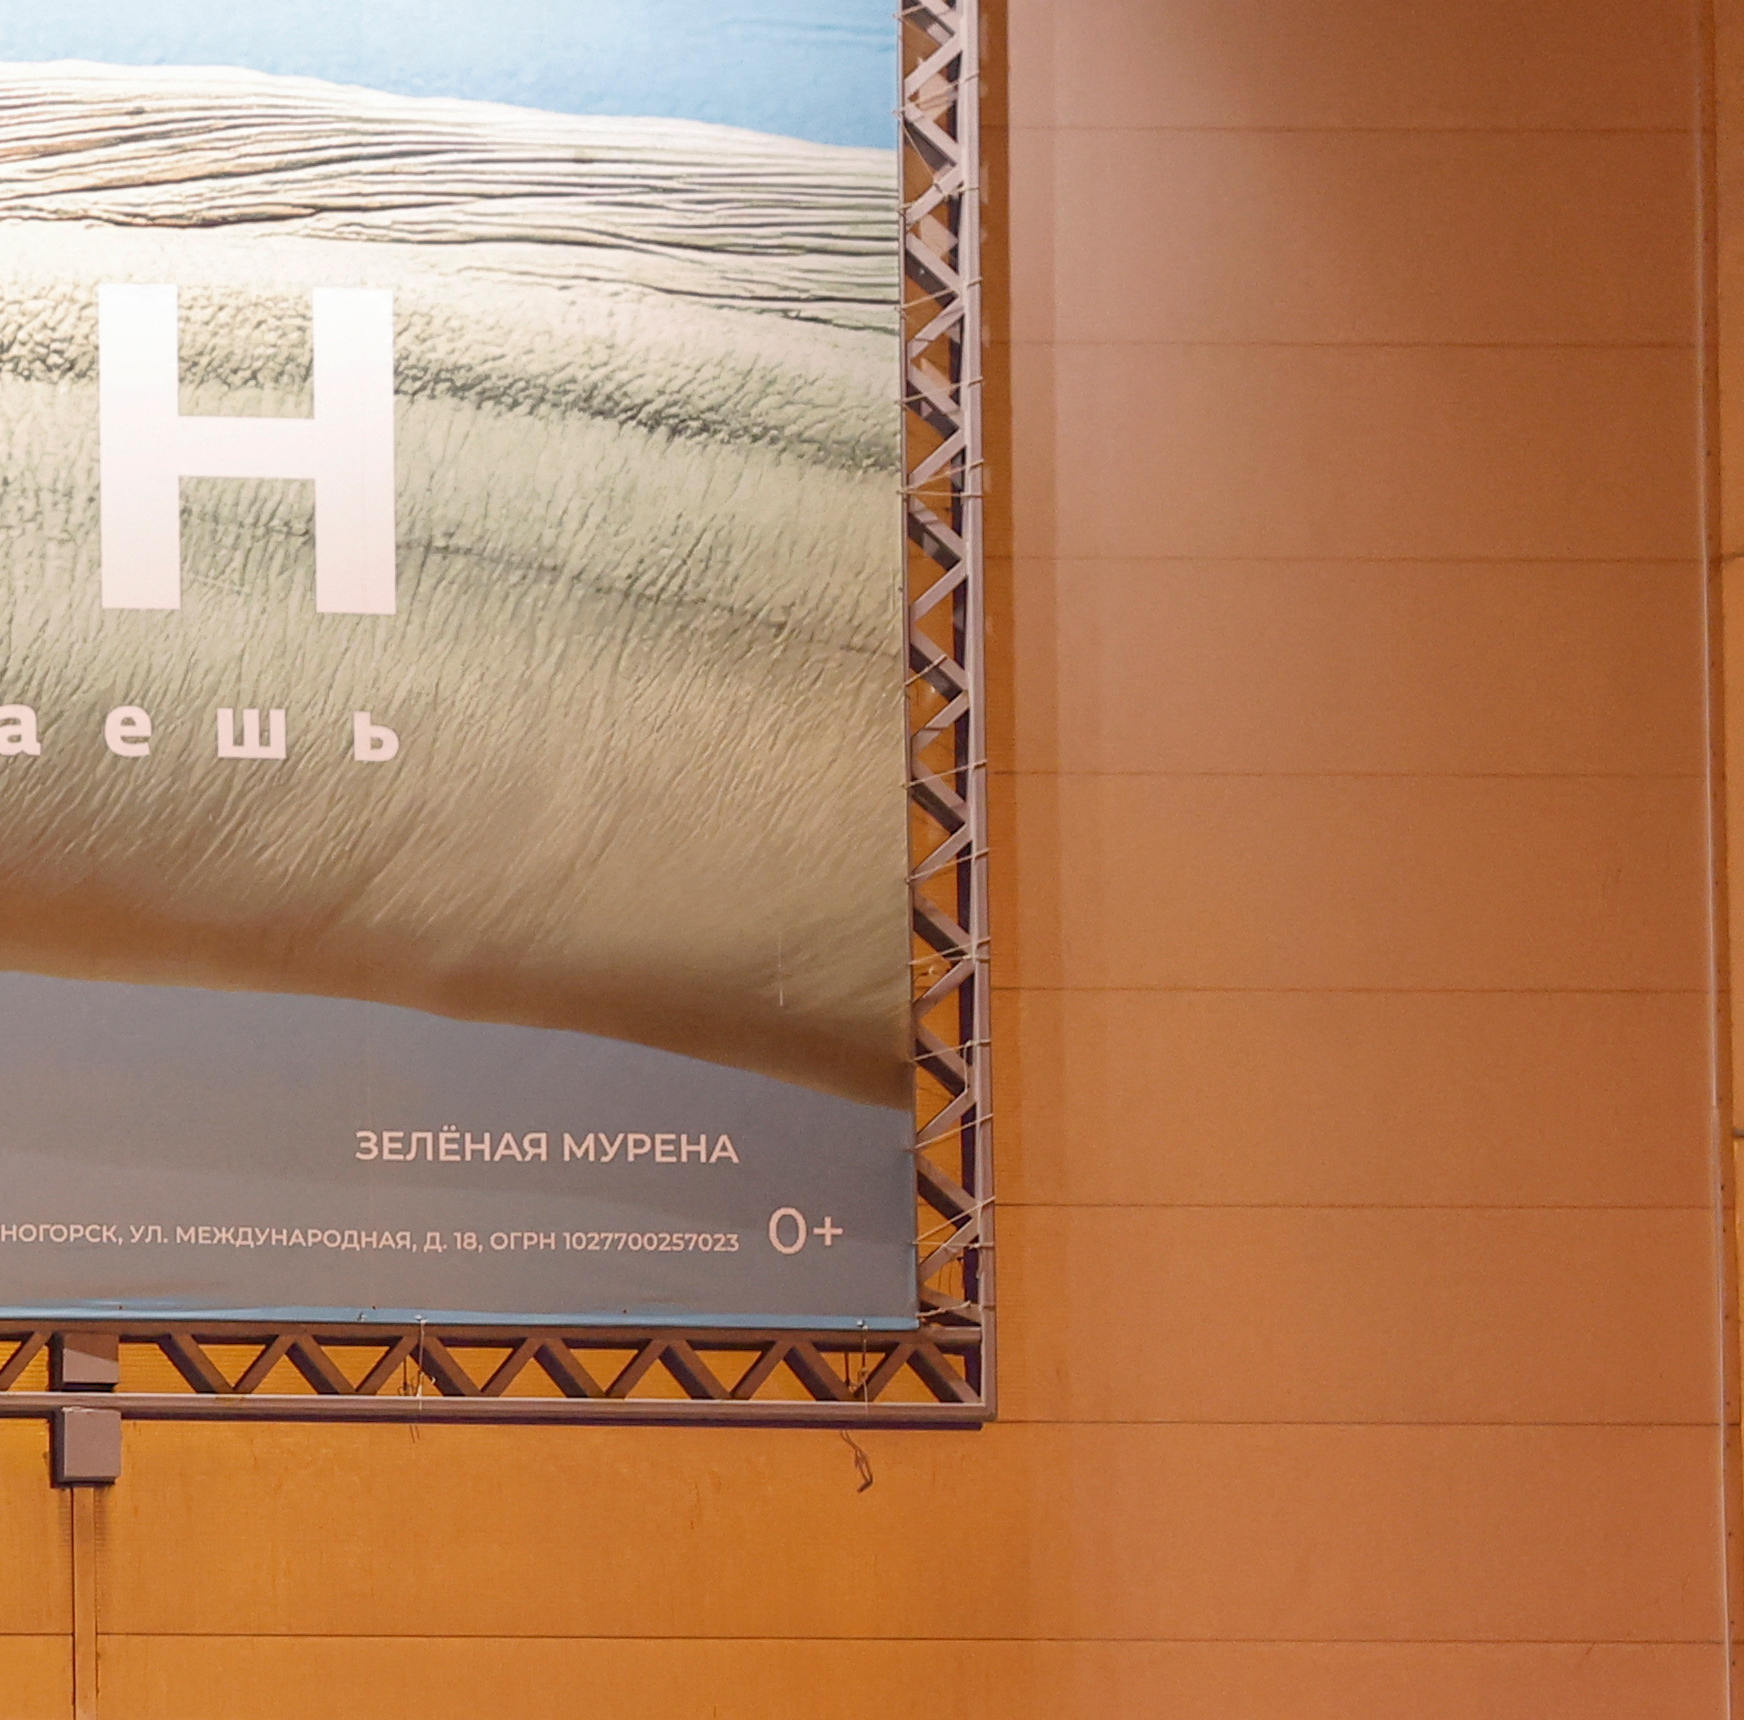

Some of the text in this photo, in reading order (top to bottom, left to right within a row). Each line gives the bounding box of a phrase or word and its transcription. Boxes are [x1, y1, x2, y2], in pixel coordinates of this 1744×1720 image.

[355, 1124, 741, 1164] ЗЕЛЁНАЯ МУРЕНА
[129, 1224, 169, 1244] УЛ.
[176, 1225, 418, 1252] МЕЖДУНАРОДНАЯ,
[423, 1230, 450, 1252] Д.
[453, 1231, 484, 1254] 18,
[489, 1231, 556, 1251] ОГРН
[562, 1231, 740, 1253] 1027700257023
[768, 1206, 844, 1256] 0+
